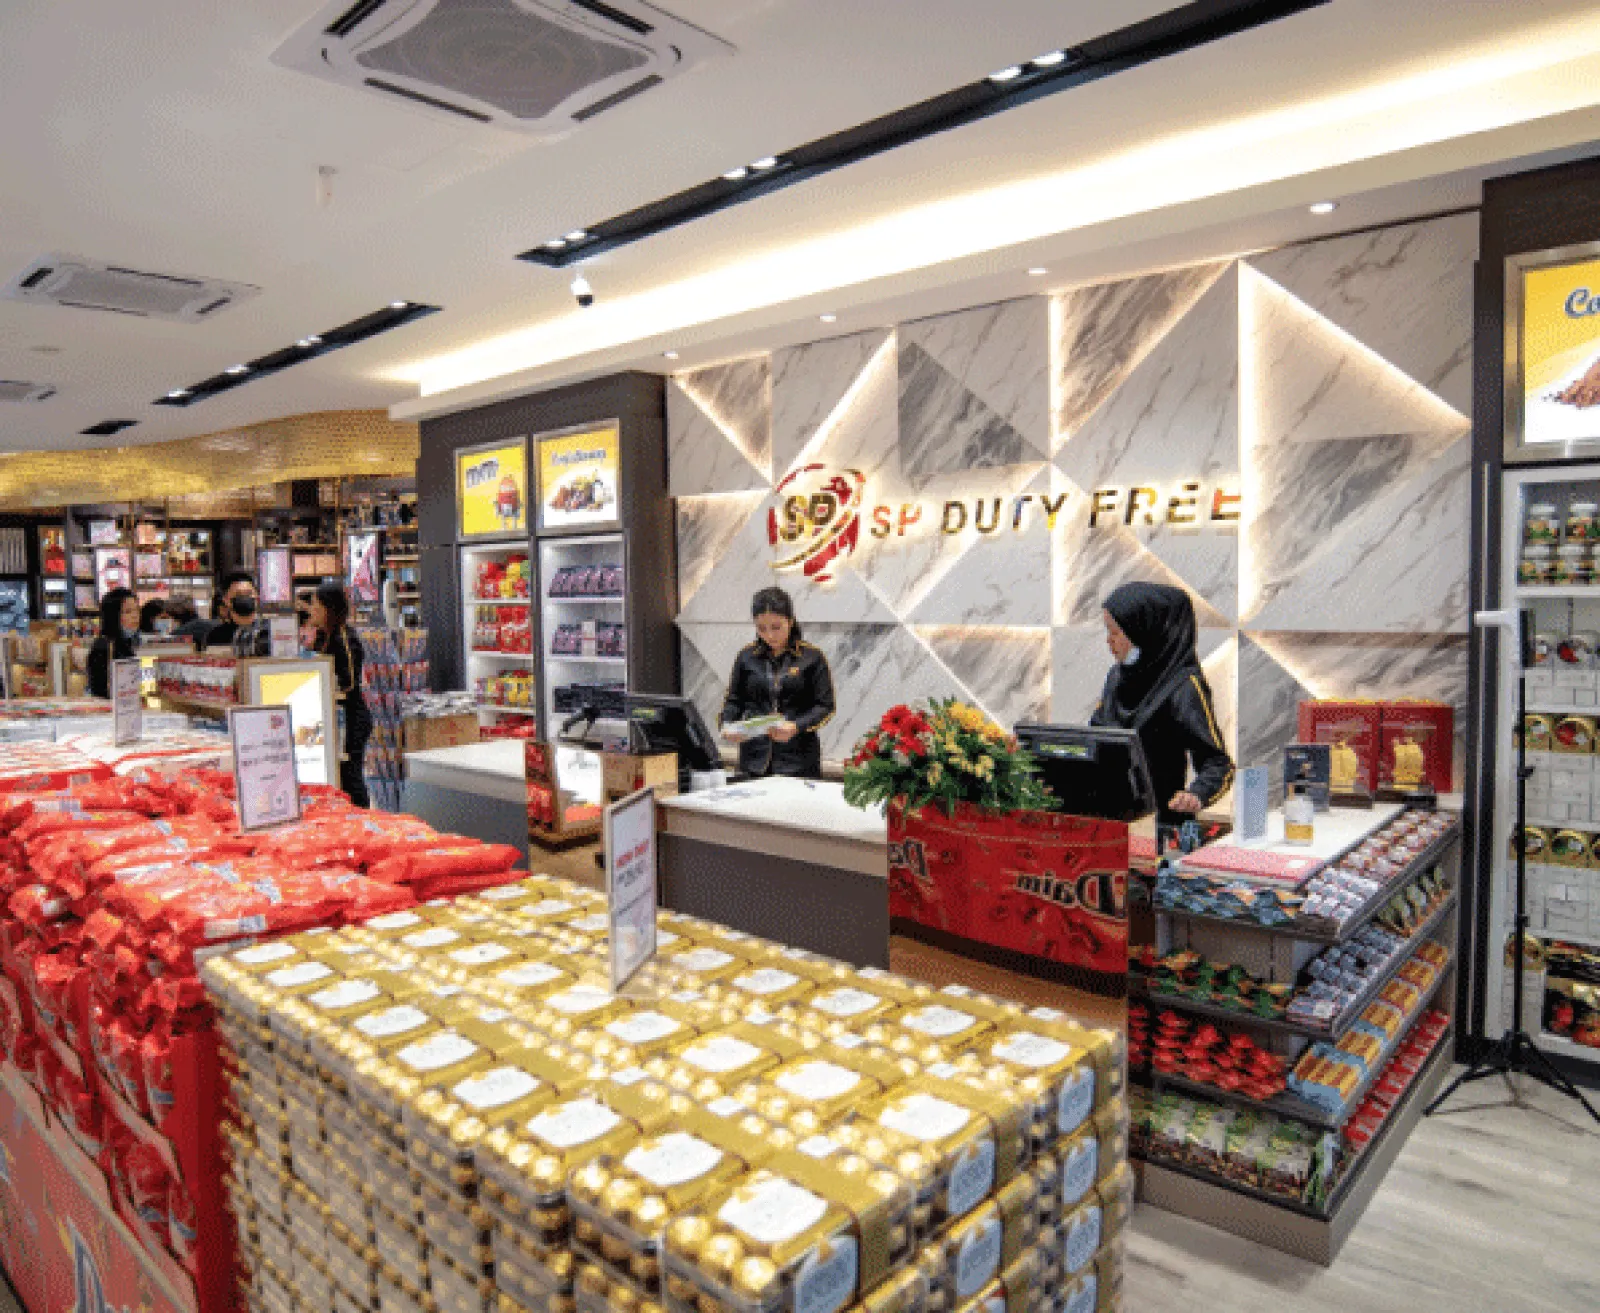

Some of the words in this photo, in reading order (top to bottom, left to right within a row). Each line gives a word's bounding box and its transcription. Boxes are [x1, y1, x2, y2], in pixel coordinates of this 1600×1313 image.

[871, 503, 921, 538] SP
[941, 492, 1067, 535] DUTY
[1089, 482, 1242, 528] FREE
